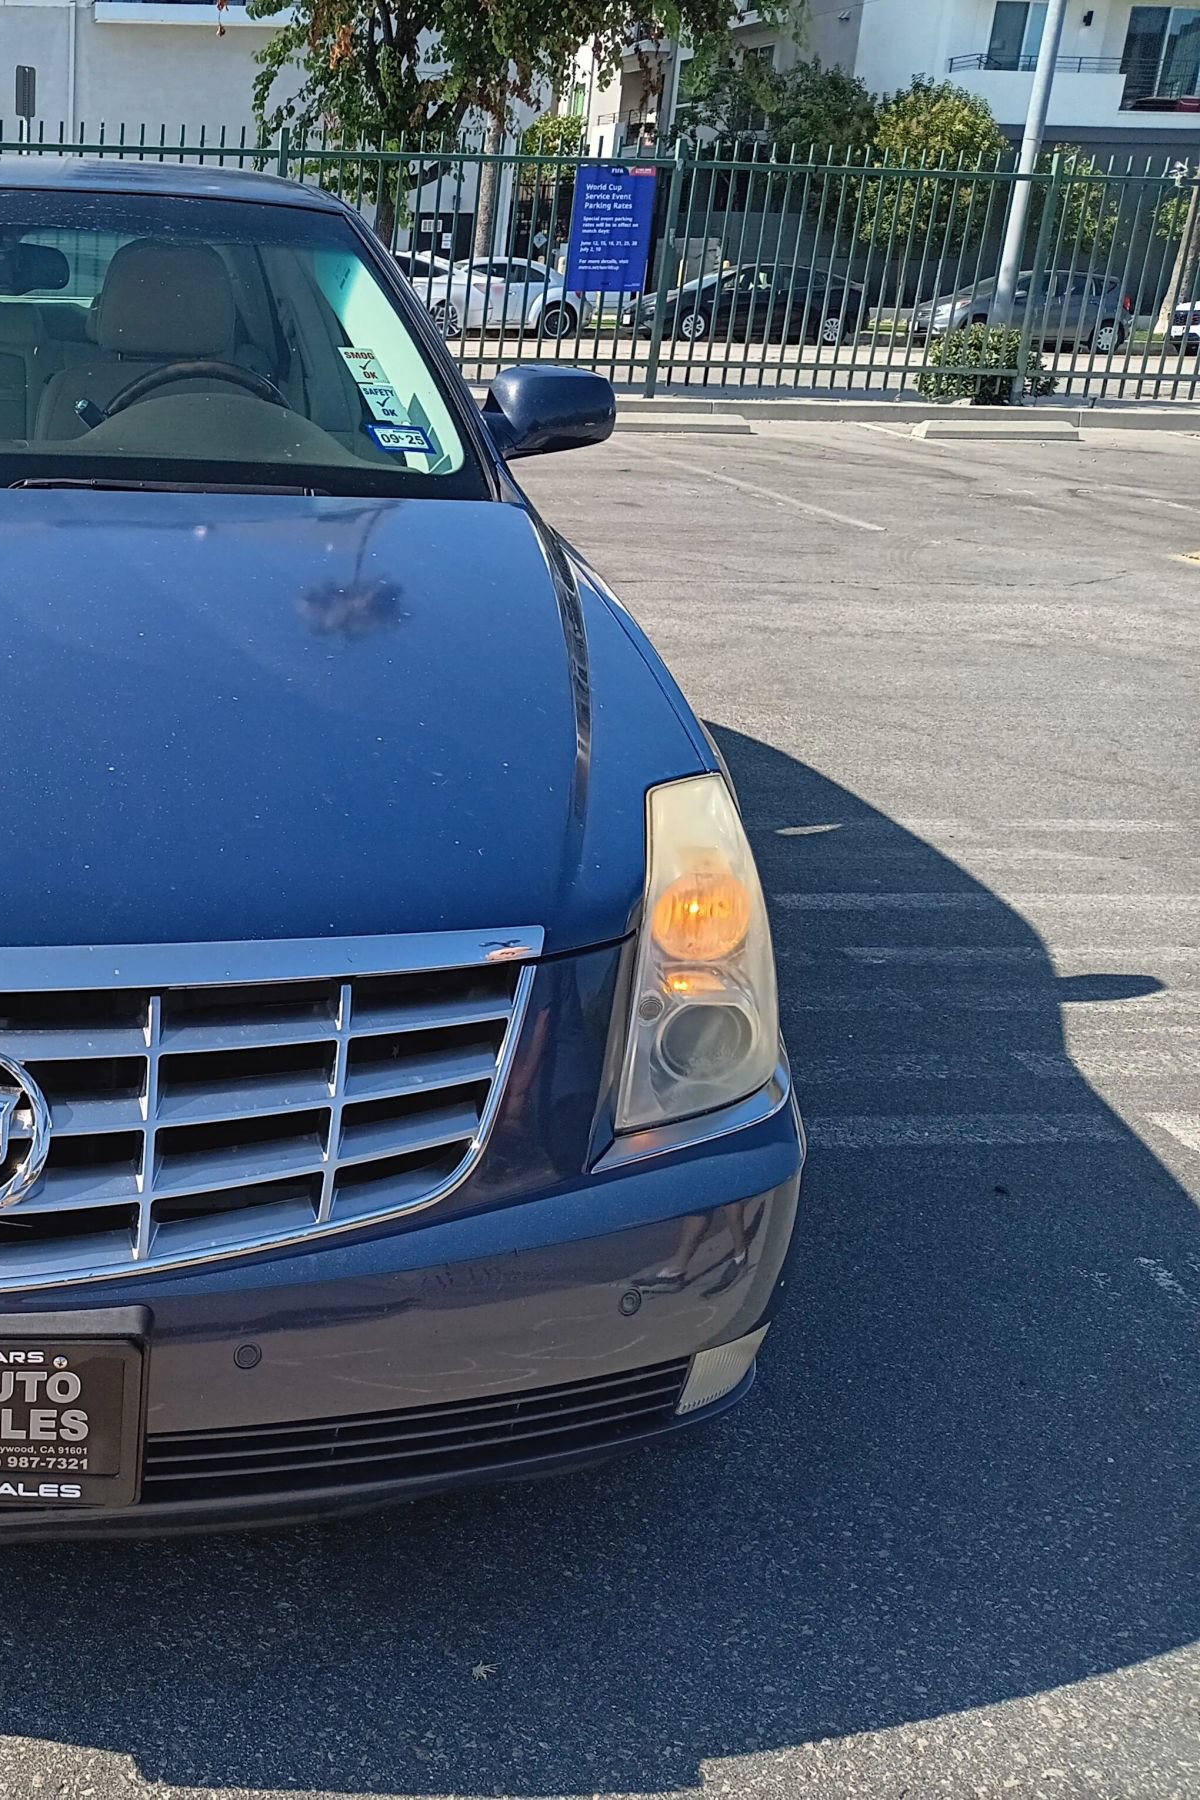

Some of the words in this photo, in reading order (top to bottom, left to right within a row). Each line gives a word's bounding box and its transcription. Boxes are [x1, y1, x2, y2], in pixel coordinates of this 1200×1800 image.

[608, 184, 622, 192] Cup
[584, 202, 612, 211] Parking
[344, 351, 376, 360] SMOG
[362, 388, 394, 396] SAFETY
[382, 408, 398, 416] OK
[40, 1446, 55, 1454] CA
[58, 1446, 88, 1455] 91601
[7, 1456, 88, 1470] 987-7321
